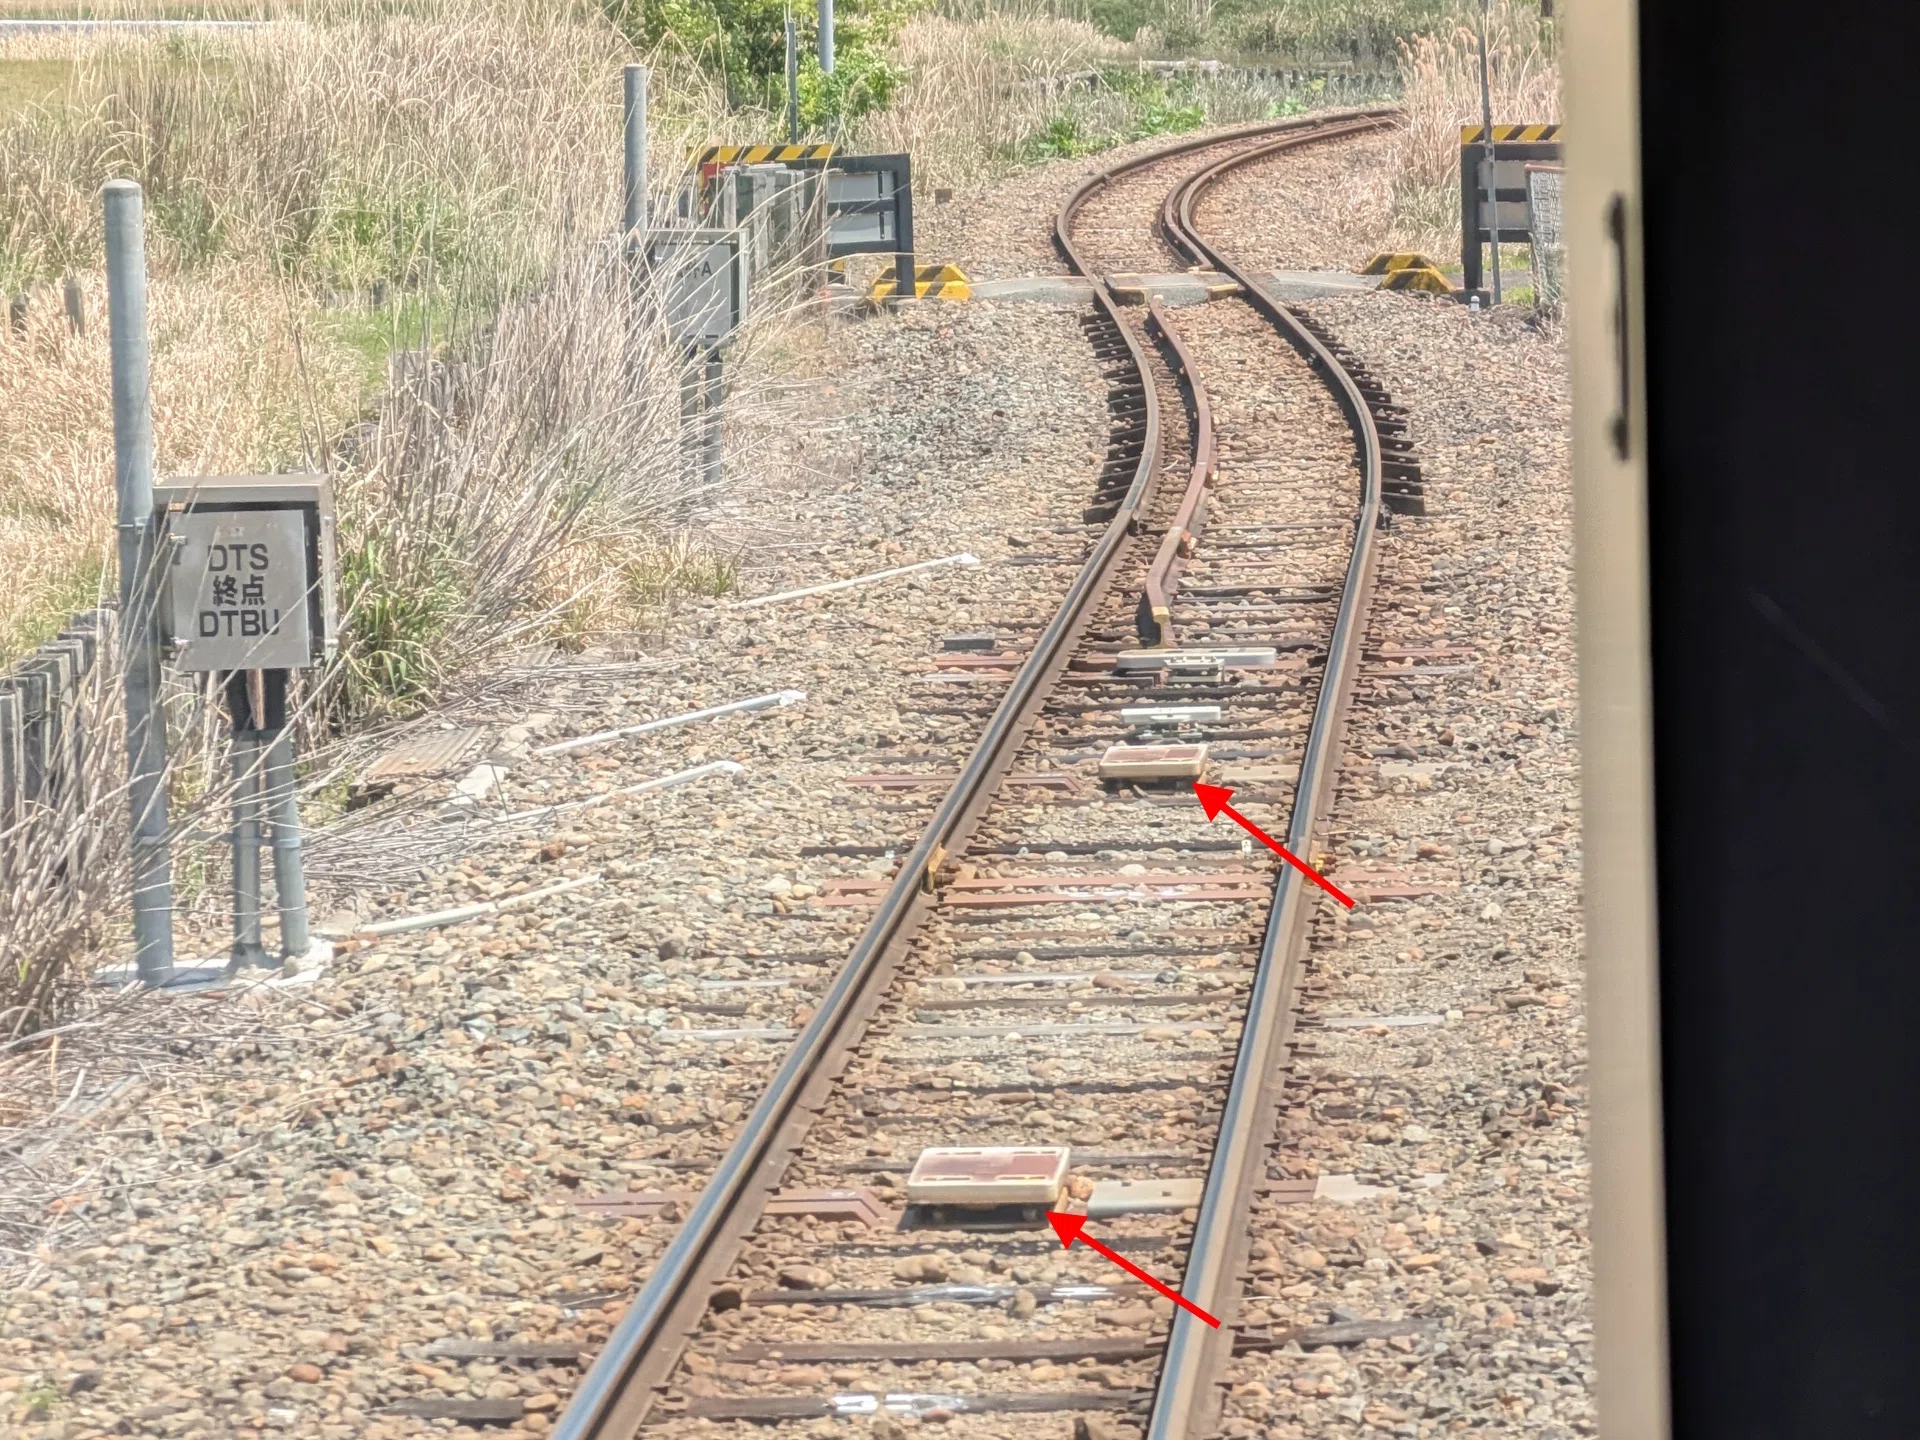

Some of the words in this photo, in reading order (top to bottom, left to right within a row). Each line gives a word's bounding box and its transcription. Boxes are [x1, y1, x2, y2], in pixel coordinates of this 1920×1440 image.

[208, 543, 269, 571] DTS
[213, 574, 265, 606] 終点
[199, 609, 279, 637] DTBU
